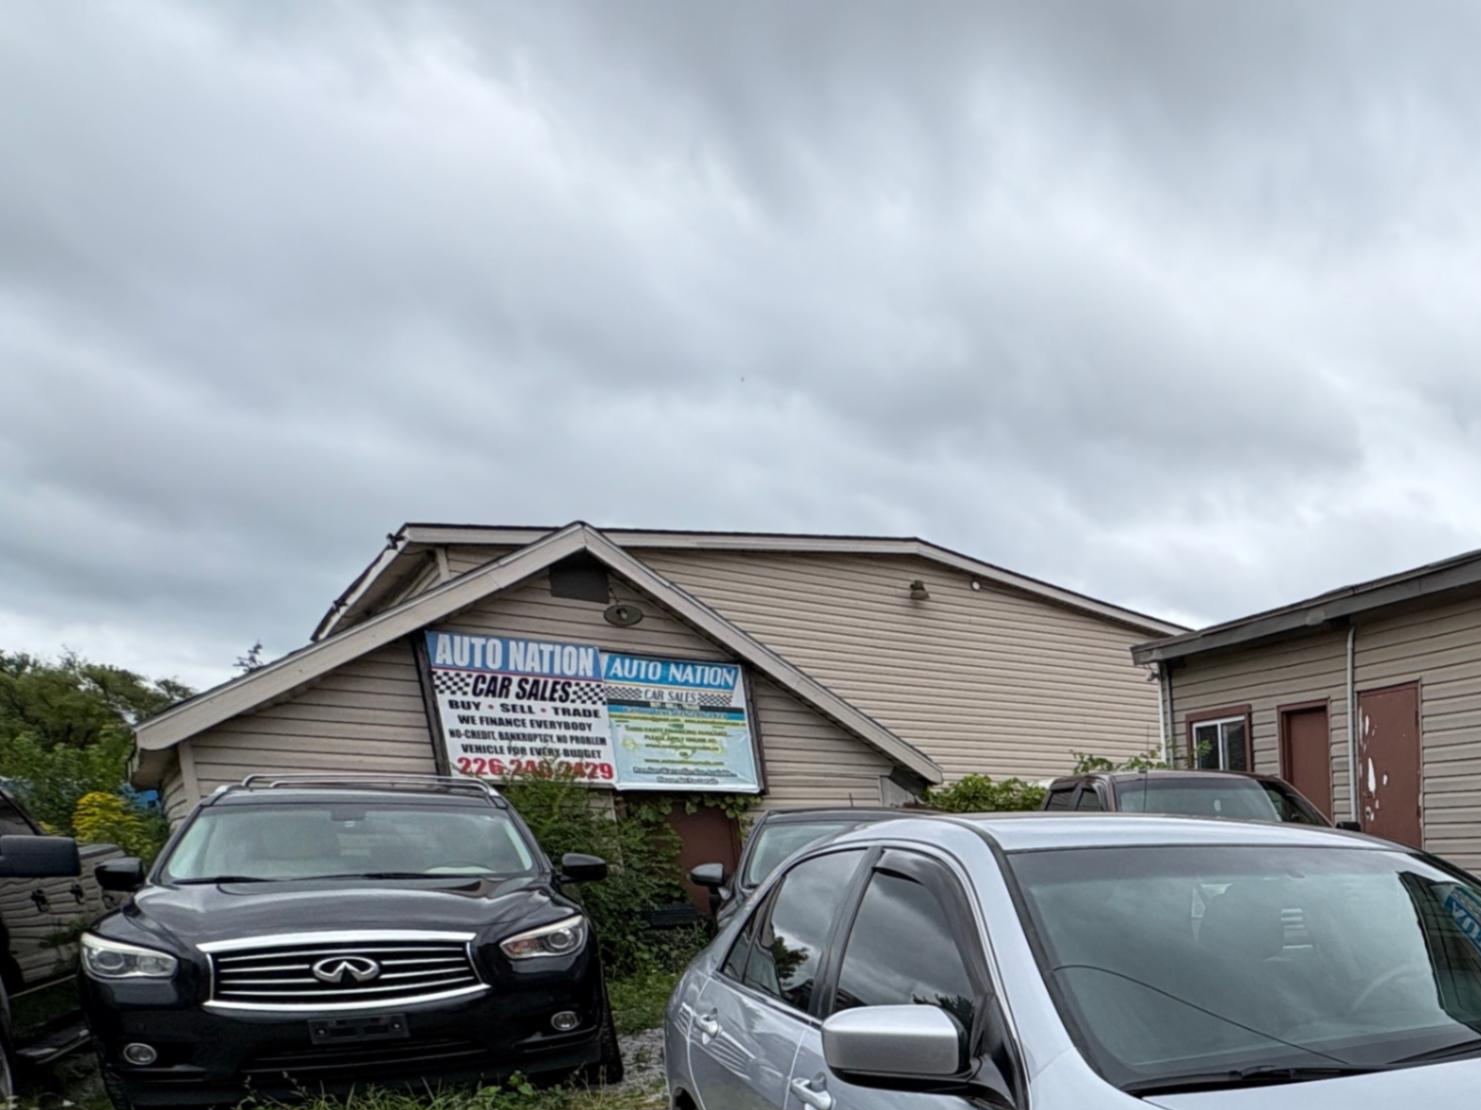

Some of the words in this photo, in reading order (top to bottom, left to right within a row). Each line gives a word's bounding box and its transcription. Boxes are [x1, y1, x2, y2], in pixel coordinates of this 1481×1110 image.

[436, 633, 503, 670] AUTO
[508, 640, 595, 677] NATION
[609, 657, 661, 681] AUTO
[668, 663, 736, 688] NATION
[472, 674, 512, 699] CAR
[515, 677, 572, 703] SALES
[644, 689, 664, 701] CAR
[667, 691, 698, 703] SALES
[448, 699, 481, 711] BUY
[500, 703, 536, 714] SELL
[552, 706, 601, 719] TRADE
[457, 714, 477, 725] WE
[480, 716, 527, 729] FINANCE
[530, 719, 593, 732] EVERYBODY
[557, 735, 568, 745] NO
[569, 736, 607, 746] PROBLEM
[461, 743, 505, 756] VEHICLE
[507, 746, 527, 757] FOR
[530, 746, 561, 758] EVERY
[563, 748, 602, 759] BUDGET
